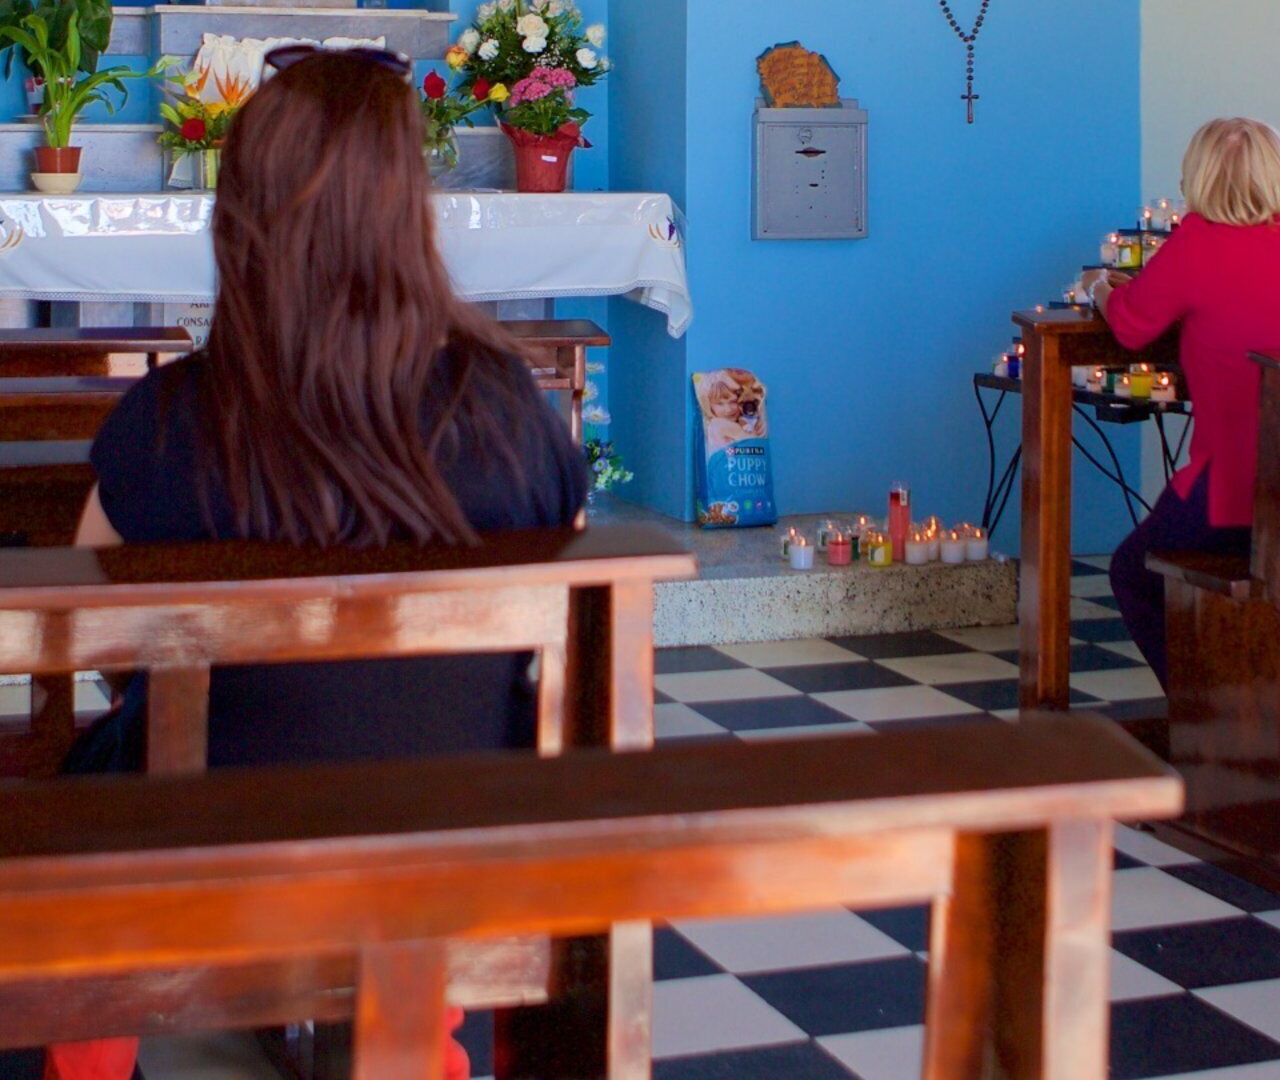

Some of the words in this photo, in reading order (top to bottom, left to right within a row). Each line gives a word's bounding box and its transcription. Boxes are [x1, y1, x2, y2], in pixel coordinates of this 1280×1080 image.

[176, 316, 213, 327] CONSA
[728, 457, 766, 471] PUPPY
[728, 472, 766, 486] CHOW
